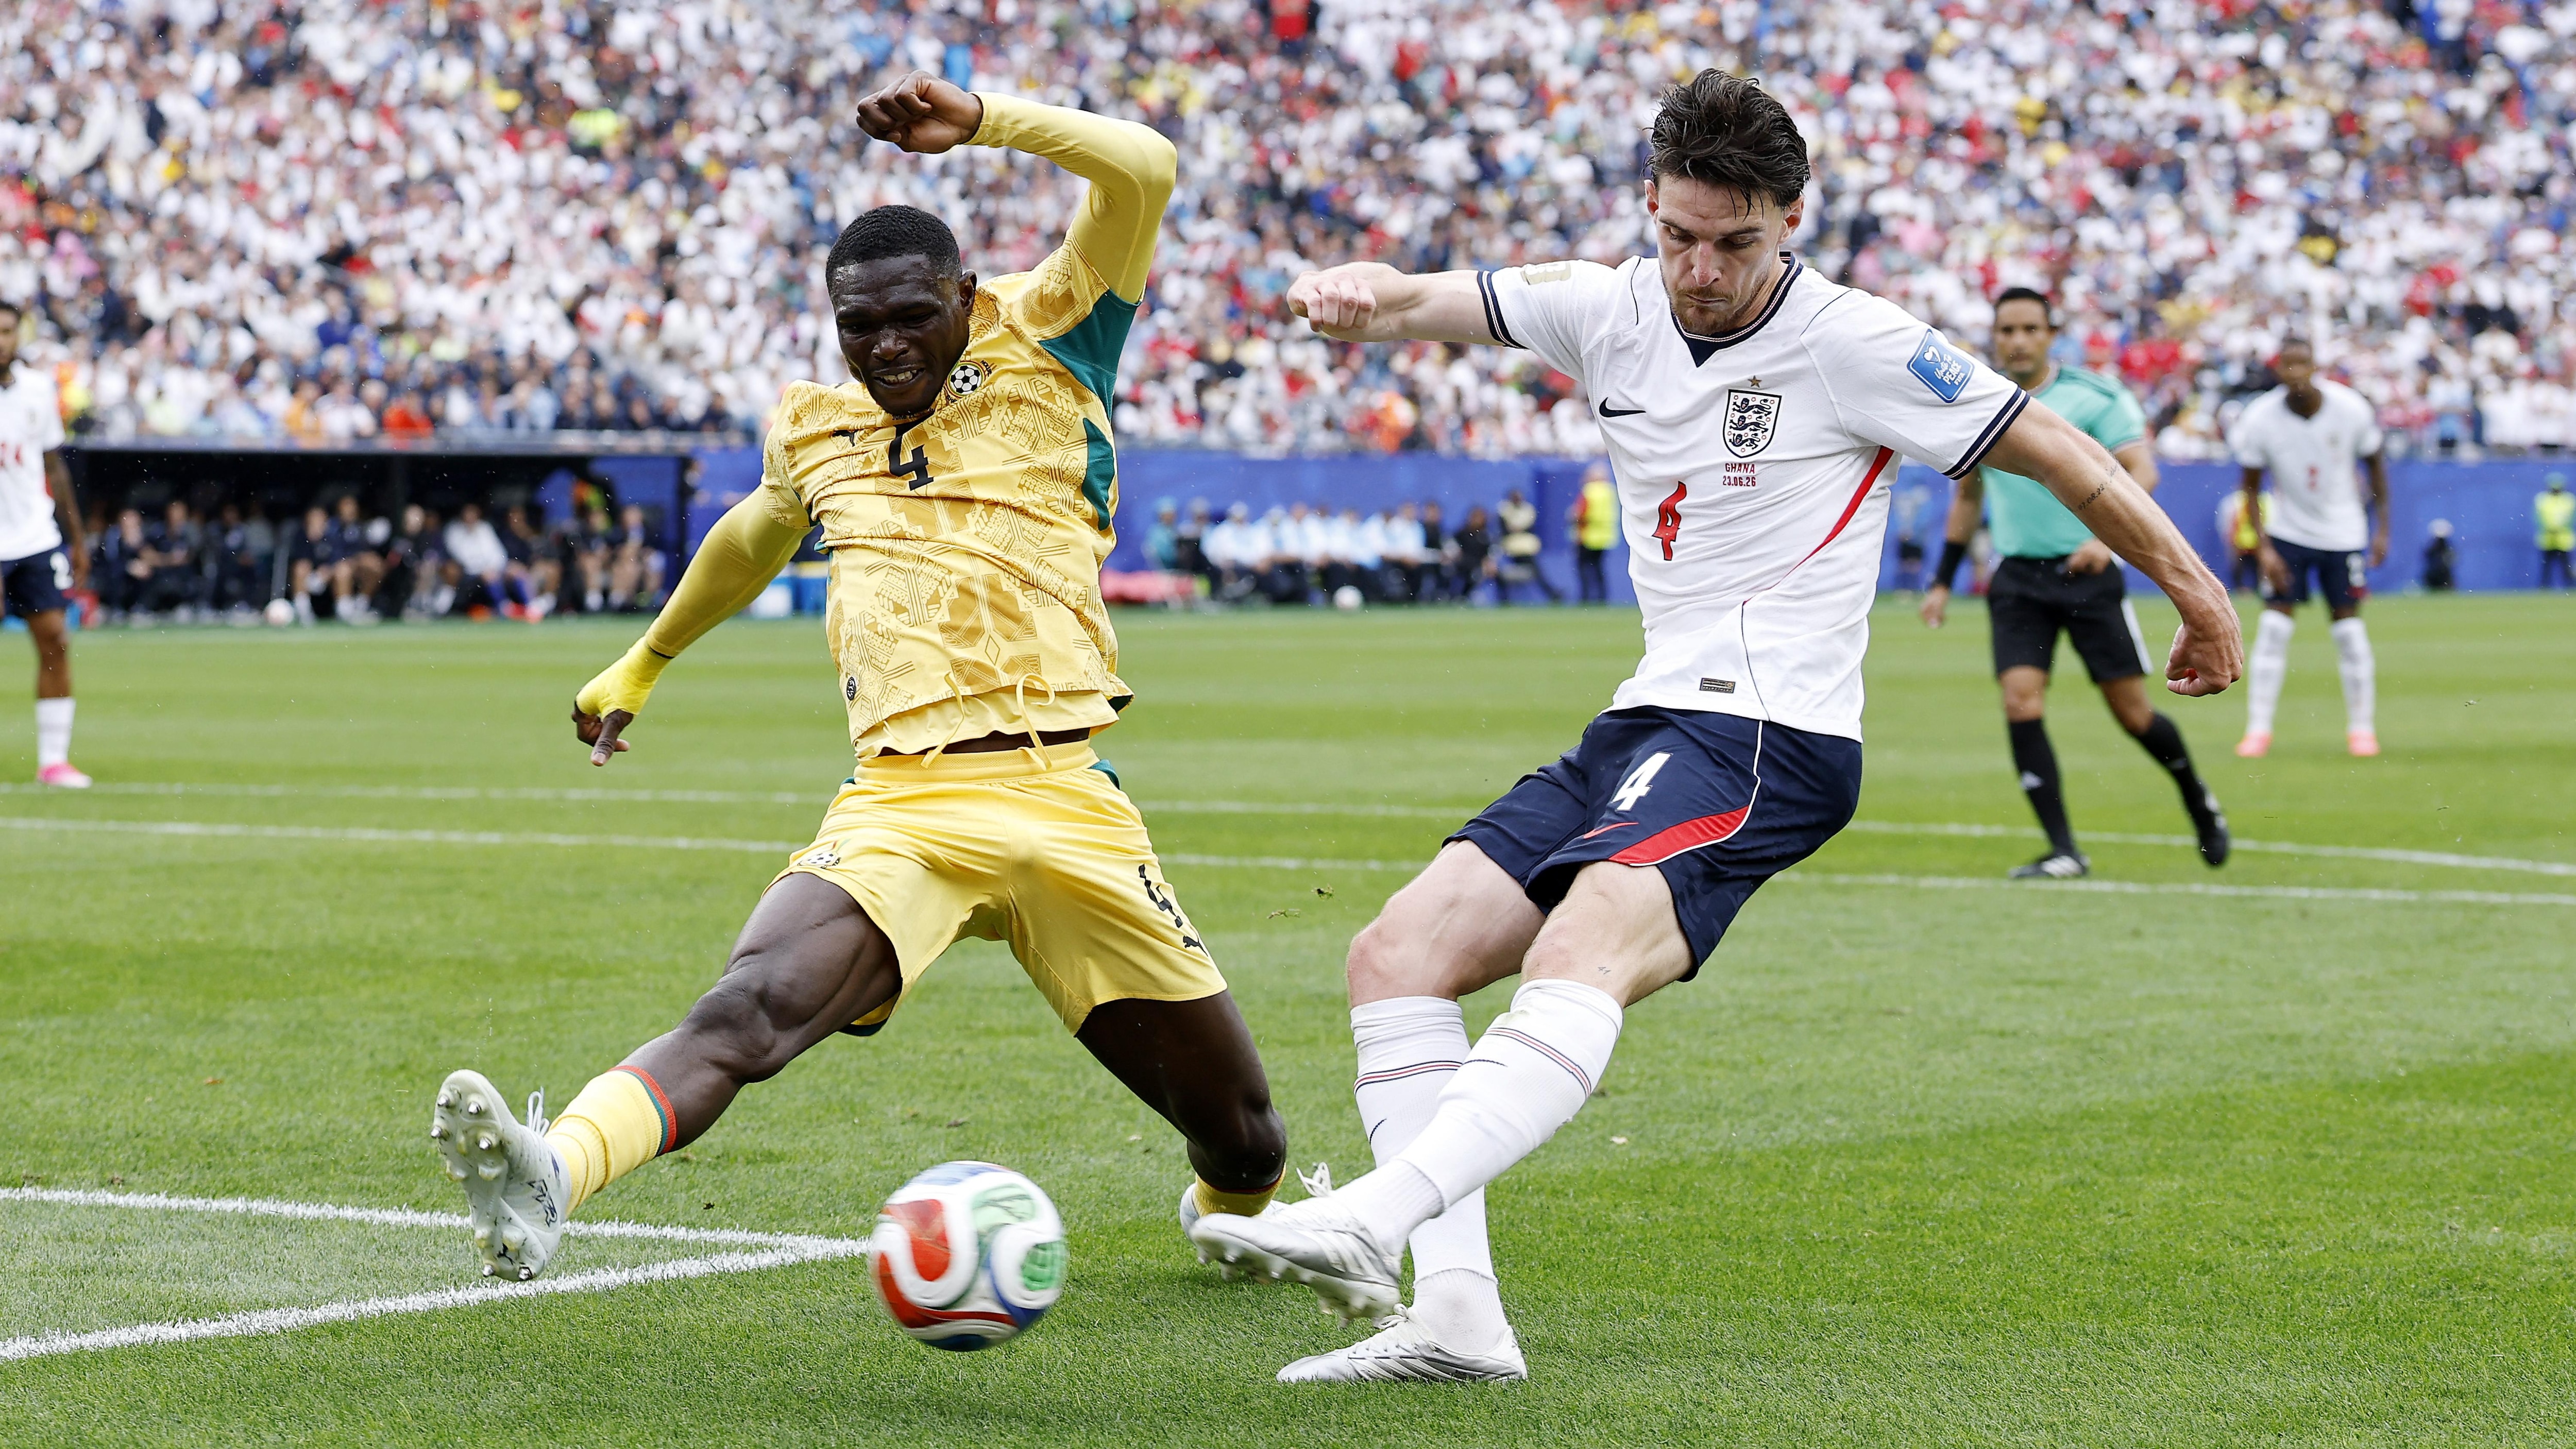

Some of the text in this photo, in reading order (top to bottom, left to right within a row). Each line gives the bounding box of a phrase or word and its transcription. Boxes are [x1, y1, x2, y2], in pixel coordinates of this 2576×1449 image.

[1942, 360, 1962, 385] PEACE
[1953, 372, 1965, 386] FIFA
[888, 431, 934, 491] 4
[1725, 463, 1755, 474] GHANA
[1722, 475, 1756, 487] 23.06.26
[1651, 481, 1687, 561] 4
[1612, 751, 1673, 812] 4
